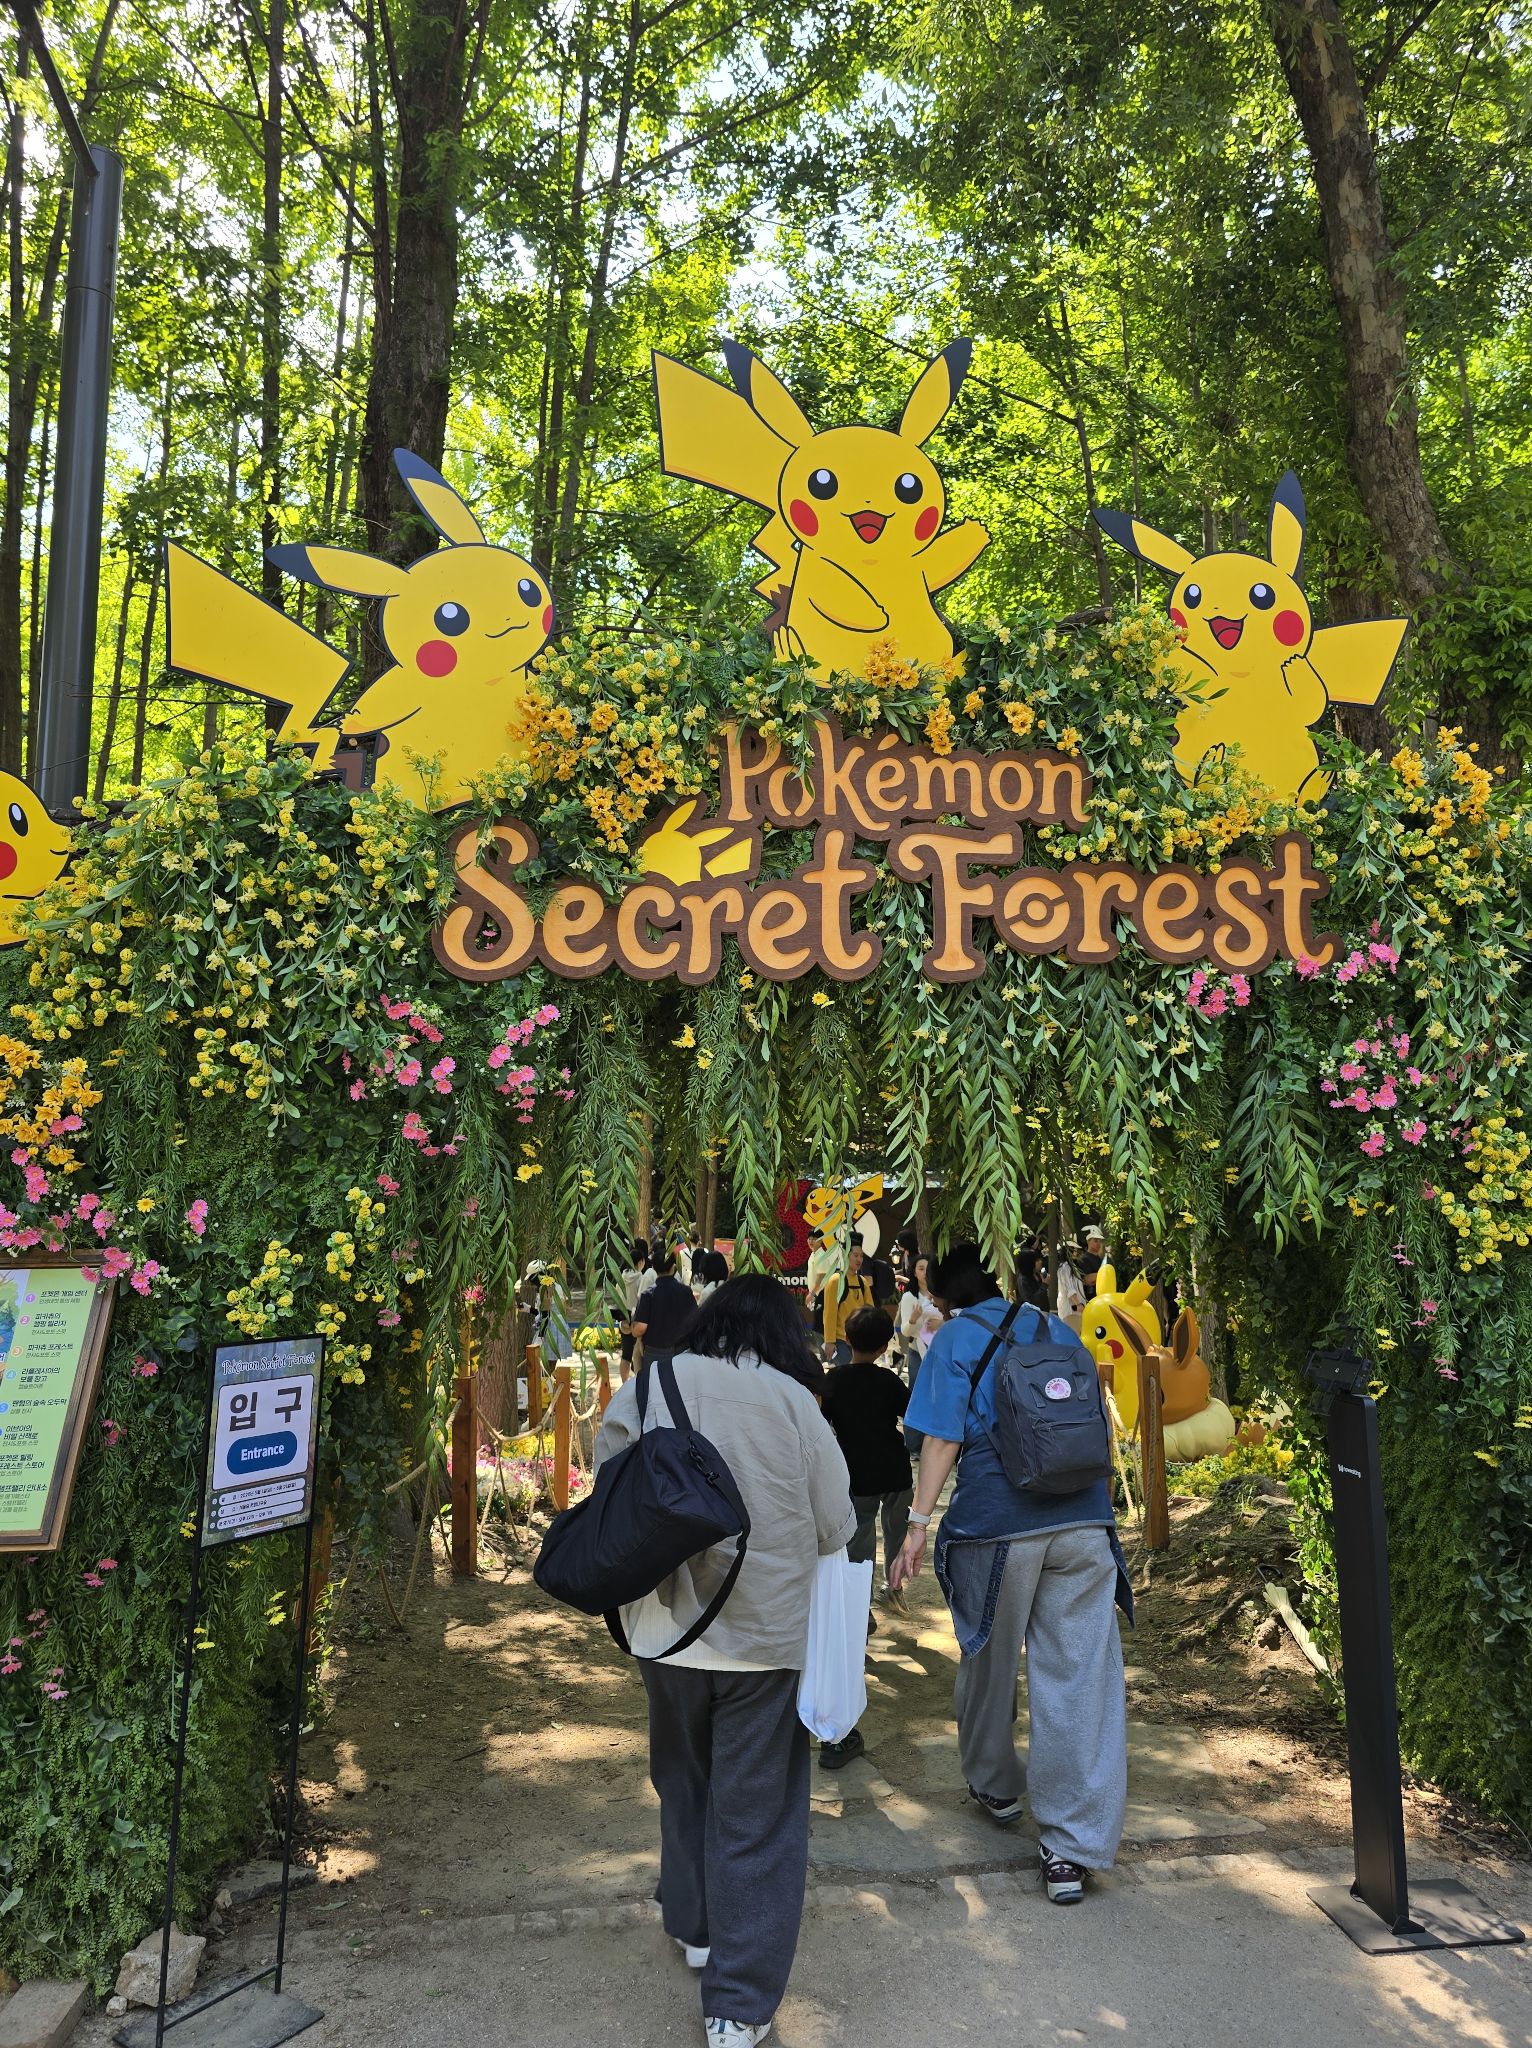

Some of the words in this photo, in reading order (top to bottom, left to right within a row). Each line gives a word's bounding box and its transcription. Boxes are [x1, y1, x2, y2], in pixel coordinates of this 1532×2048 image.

[726, 718, 1087, 832] Pokémon
[442, 825, 872, 974] Secret
[897, 831, 1336, 971] Forest
[222, 1359, 260, 1375] Pokémon
[260, 1354, 287, 1371] Secret
[287, 1351, 316, 1367] Forest
[241, 1443, 284, 1461] Entrance
